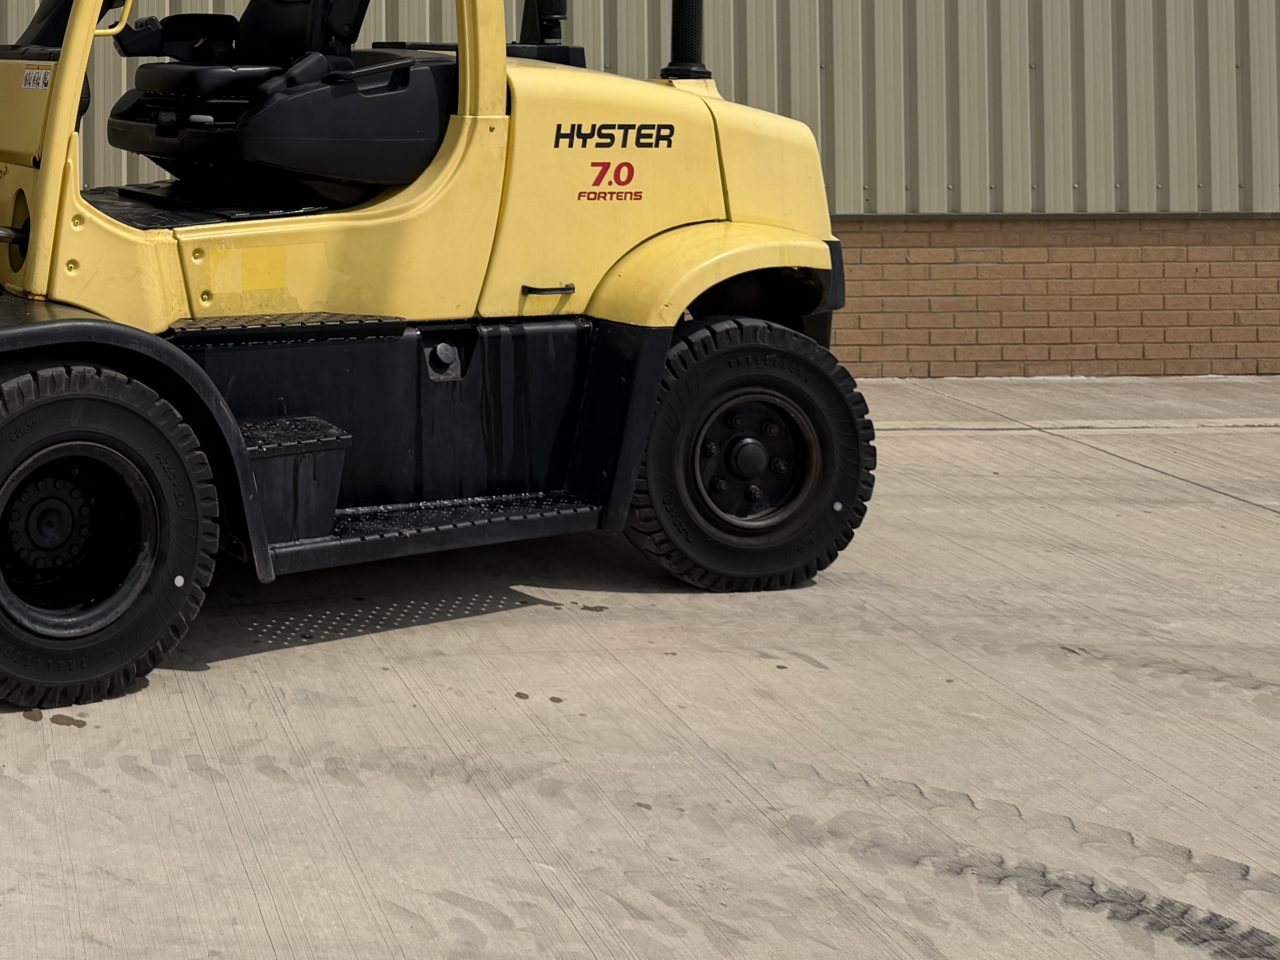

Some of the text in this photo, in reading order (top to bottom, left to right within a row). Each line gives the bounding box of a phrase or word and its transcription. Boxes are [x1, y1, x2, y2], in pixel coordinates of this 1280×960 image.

[553, 123, 675, 149] HYSTER
[590, 161, 635, 187] 7.0
[577, 191, 643, 201] FORTENS
